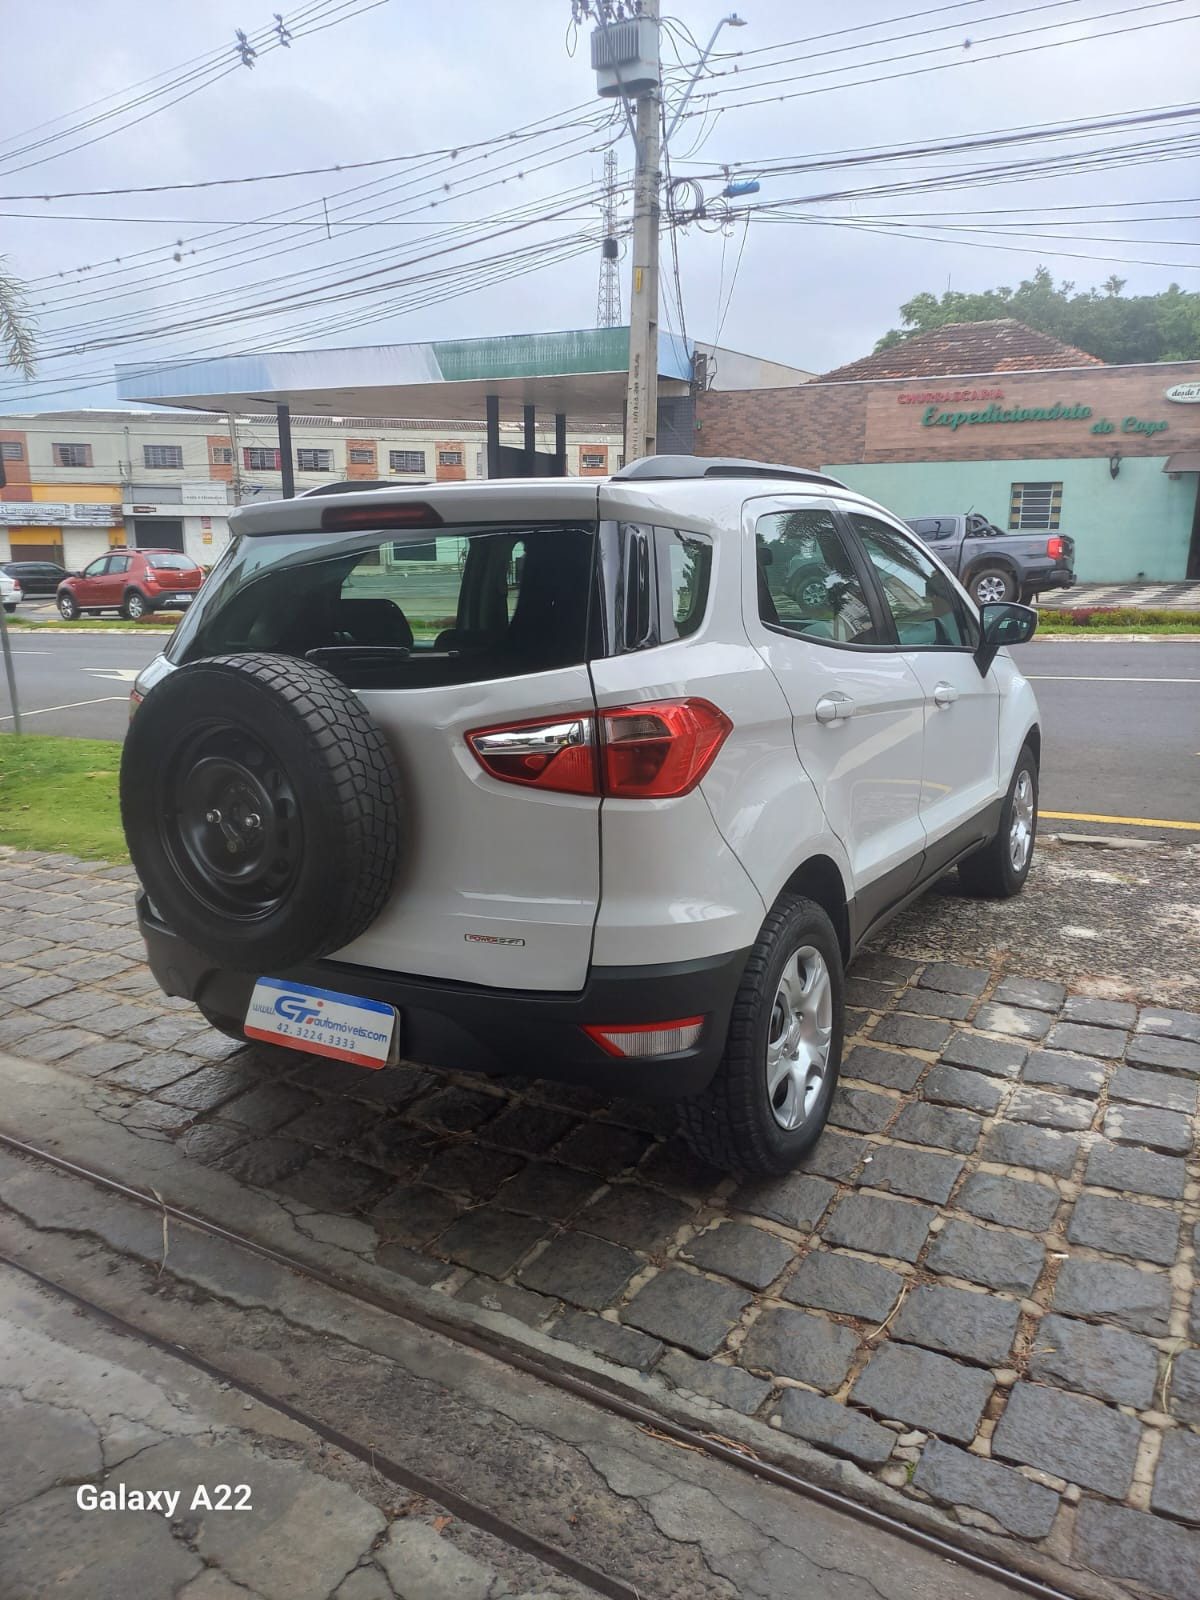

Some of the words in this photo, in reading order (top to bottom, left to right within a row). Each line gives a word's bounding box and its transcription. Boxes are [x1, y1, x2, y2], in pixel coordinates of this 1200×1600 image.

[897, 389, 1005, 404] CHURRASCARIA
[921, 401, 1092, 431] Expedicionário
[1090, 417, 1115, 434] do
[276, 1022, 356, 1050] 42.3224.3333
